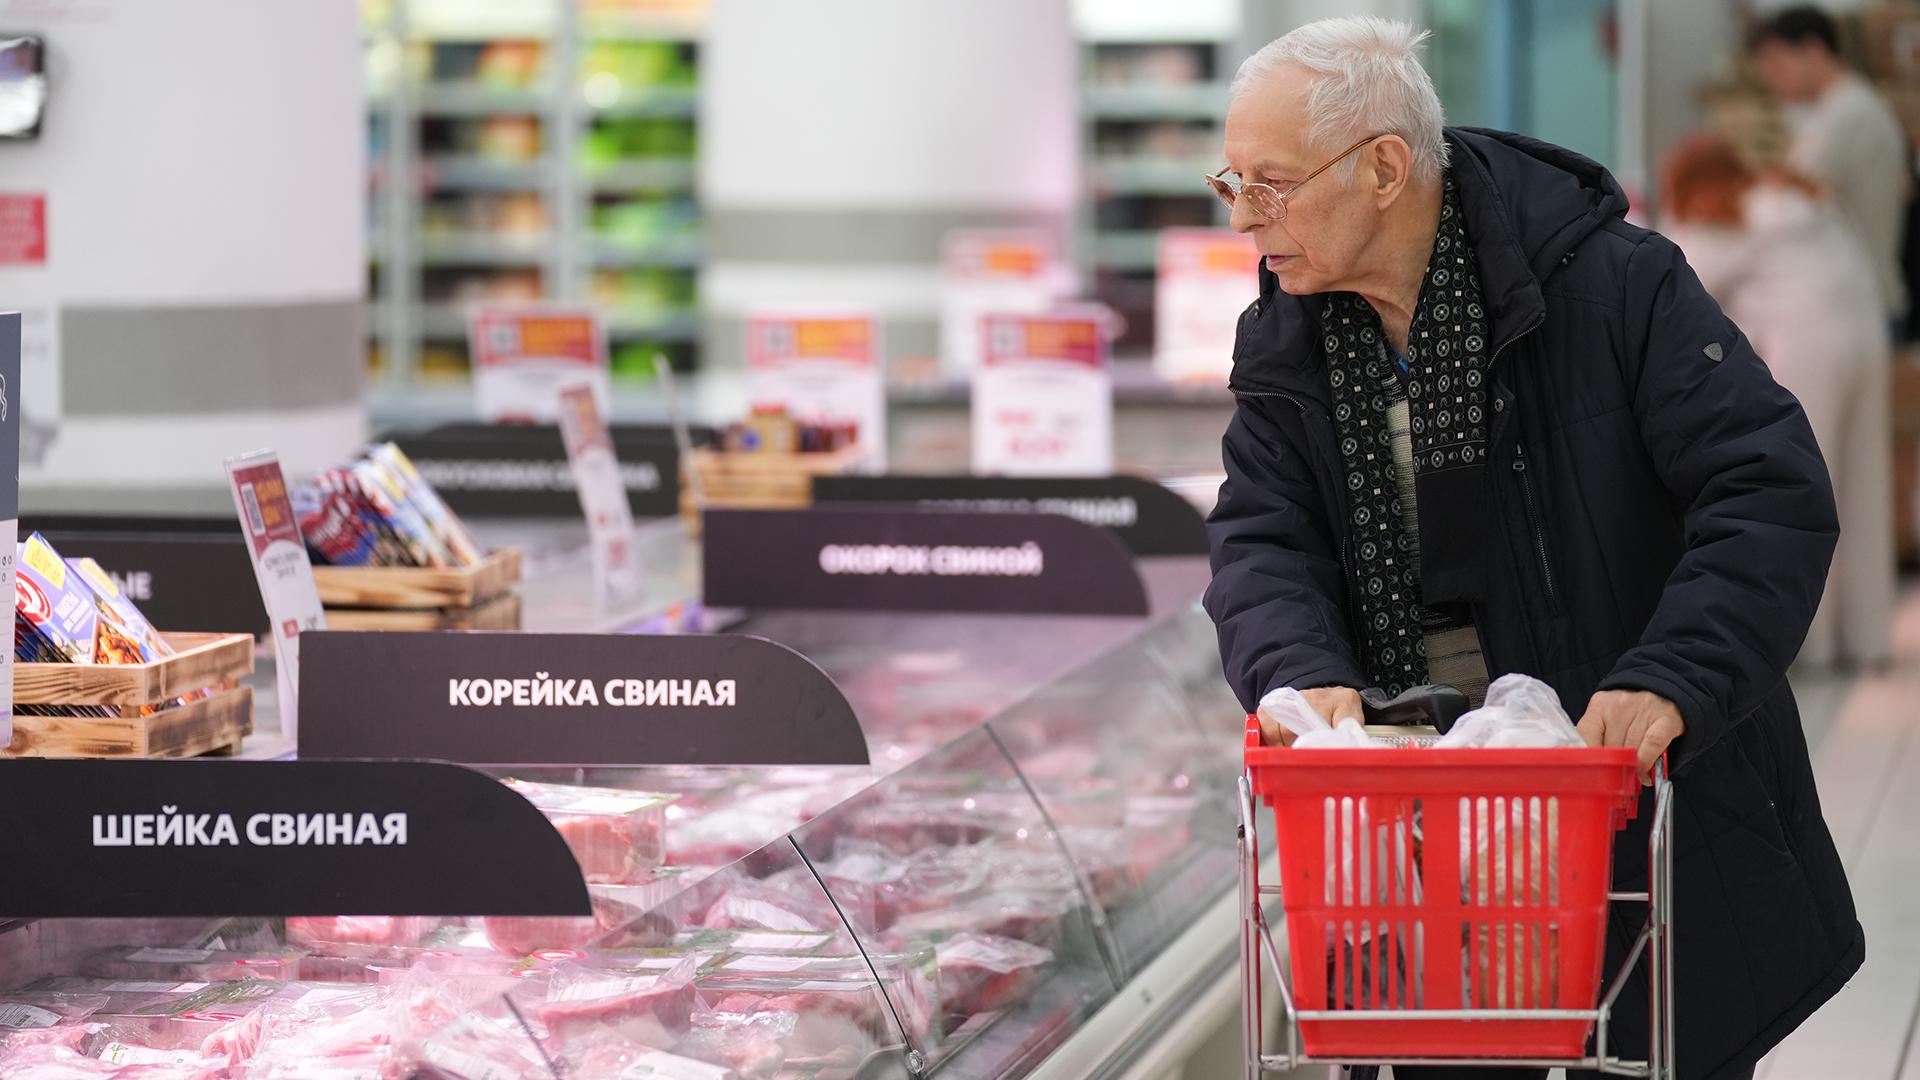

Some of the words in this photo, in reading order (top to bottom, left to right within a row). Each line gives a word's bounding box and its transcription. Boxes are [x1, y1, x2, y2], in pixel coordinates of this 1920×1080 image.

[820, 543, 928, 575] ОКОРОК
[931, 541, 1043, 576] СВИНОЙ
[449, 671, 599, 706] КОРЕЙКА
[603, 678, 736, 706] СВИНАЯ
[92, 805, 239, 846] ШЕЙКА
[246, 813, 407, 845] СВИНАЯ
